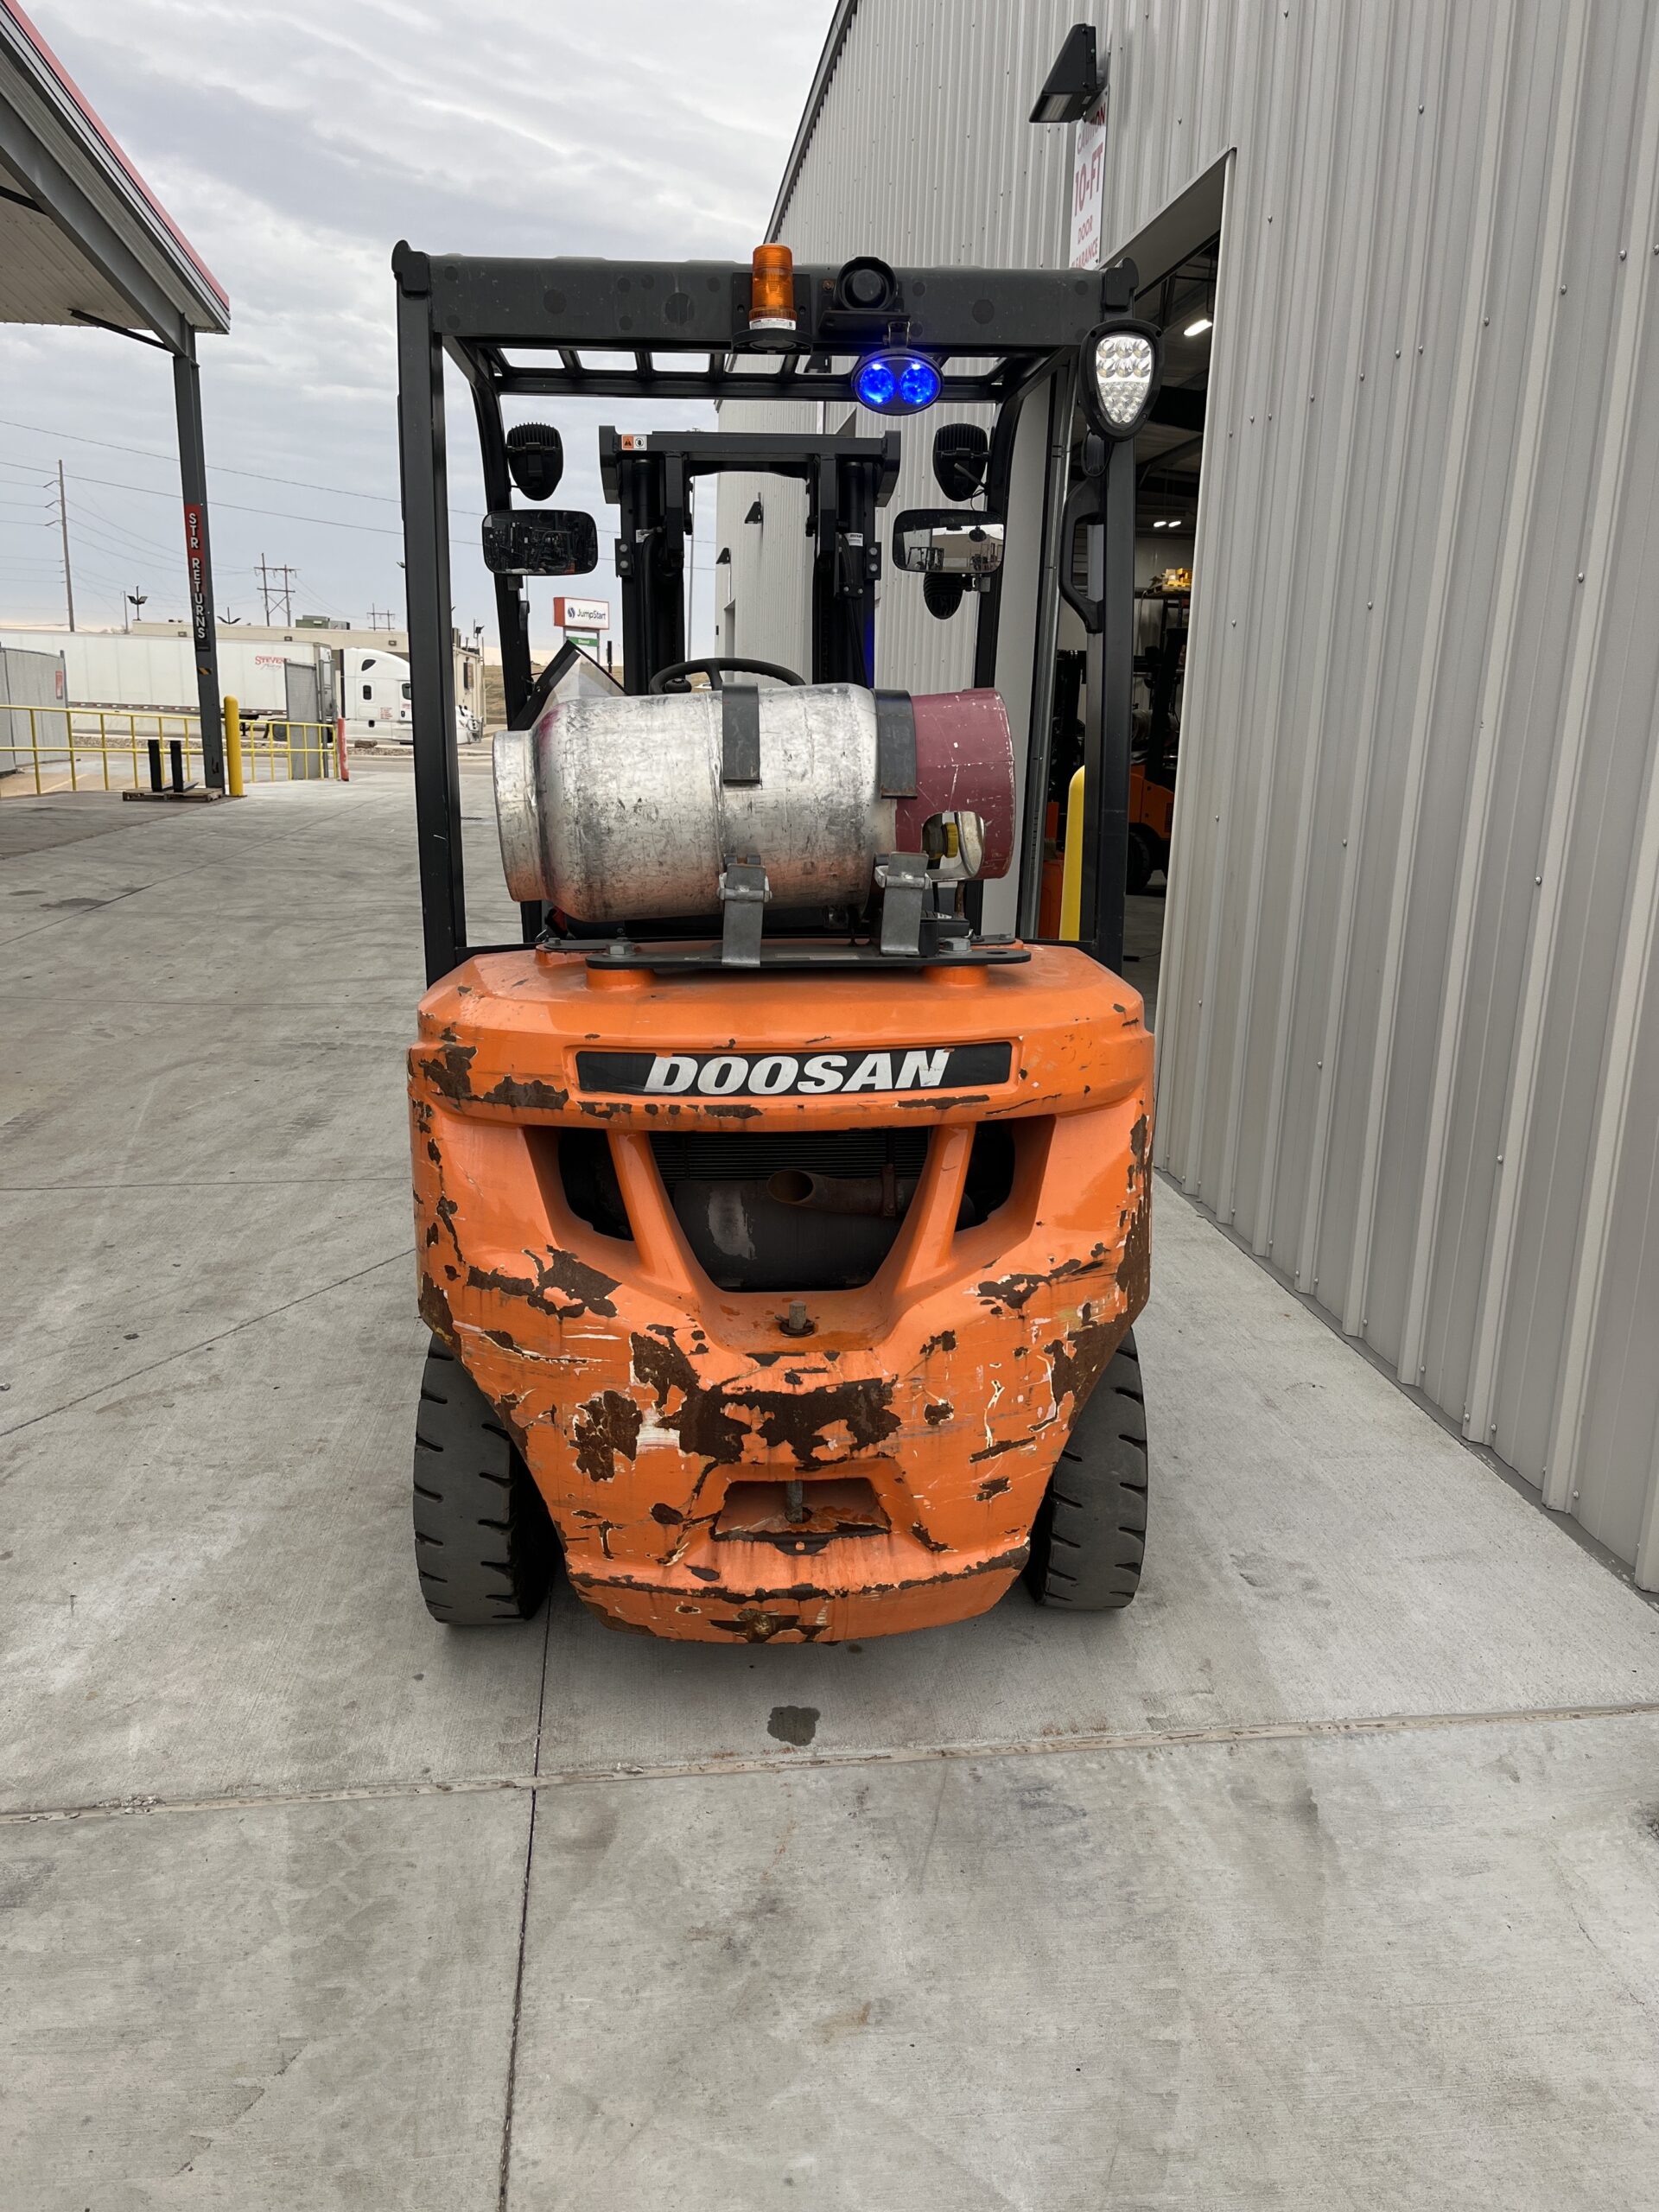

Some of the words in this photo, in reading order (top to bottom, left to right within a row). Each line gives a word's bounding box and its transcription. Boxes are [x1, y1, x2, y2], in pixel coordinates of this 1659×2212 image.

[1074, 142, 1103, 217] 10-FT
[1077, 214, 1093, 245] DOOR
[188, 512, 199, 549] STR
[192, 557, 206, 639] RETURNS
[577, 609, 606, 620] JumpStart
[644, 1048, 950, 1095] DOOSAN
